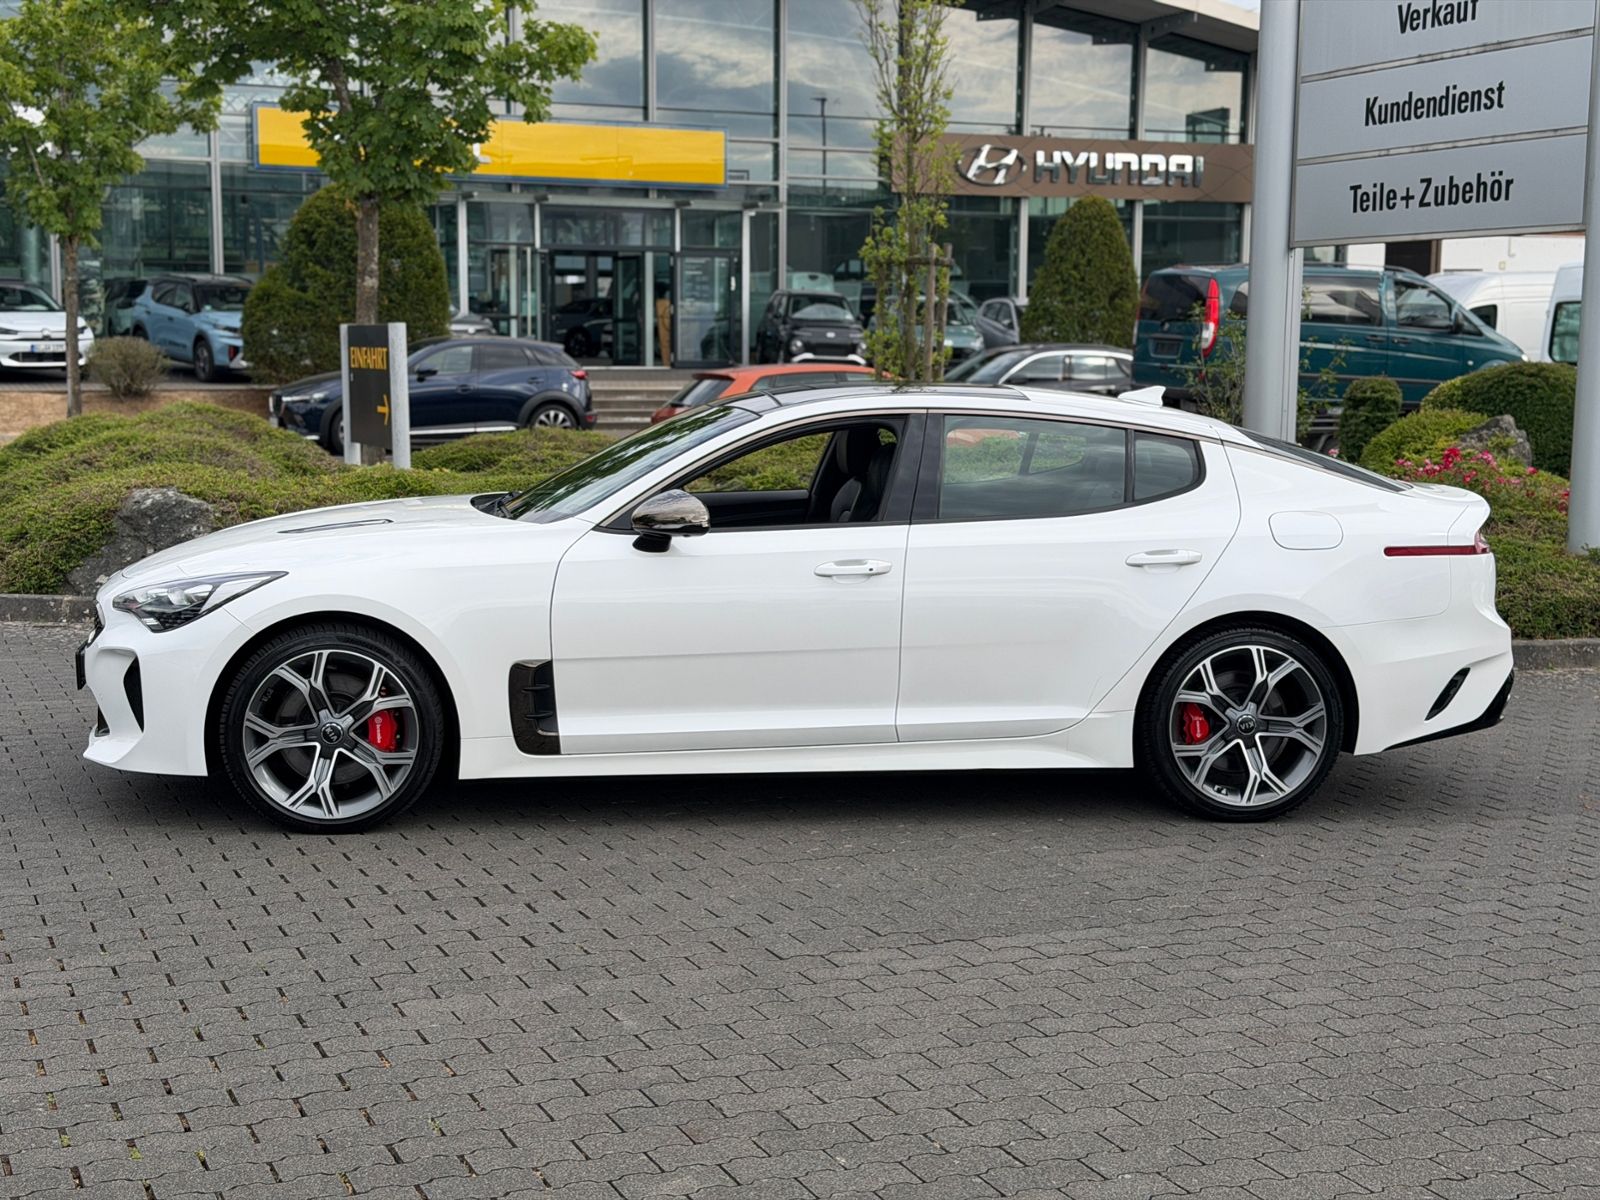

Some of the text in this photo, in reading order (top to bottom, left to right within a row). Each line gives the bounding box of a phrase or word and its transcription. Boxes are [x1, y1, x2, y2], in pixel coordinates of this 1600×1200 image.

[1364, 81, 1505, 126] Kundendienst
[1034, 149, 1204, 187] HYUNDAI
[350, 346, 387, 369] EINFAHRT
[325, 727, 338, 742] KIA
